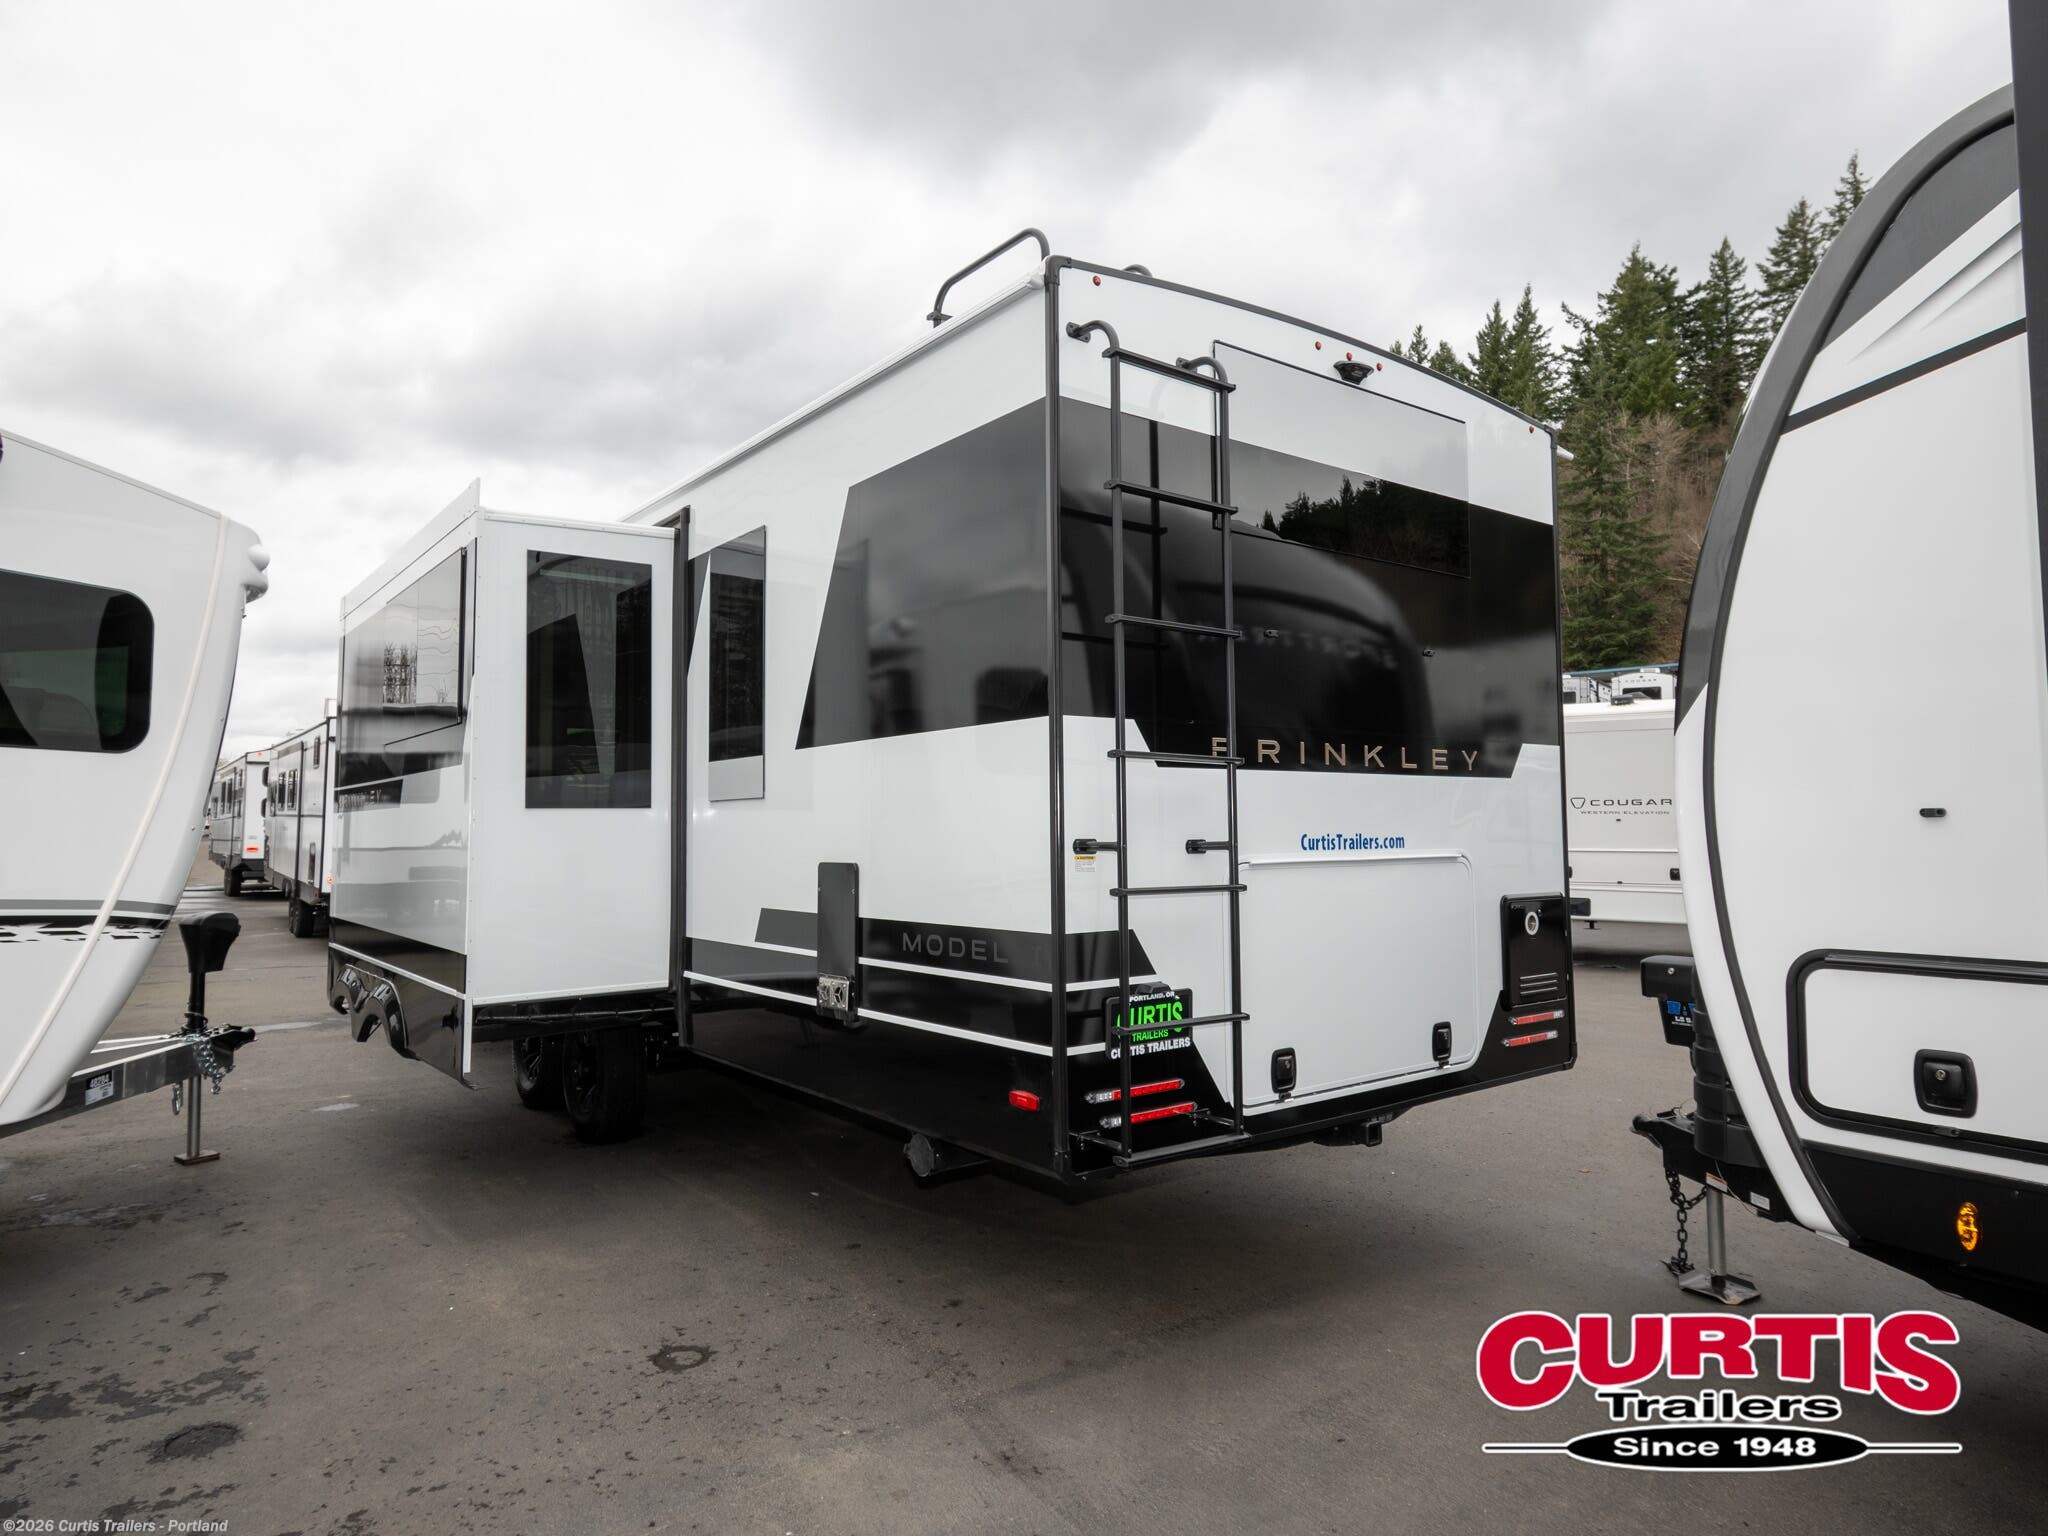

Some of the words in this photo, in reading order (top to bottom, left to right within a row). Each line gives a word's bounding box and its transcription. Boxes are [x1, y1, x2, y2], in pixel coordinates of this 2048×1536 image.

[1590, 799, 1673, 807] COUGAR
[1300, 833, 1405, 851] CurtisTrailers.com
[902, 932, 1009, 963] MODEL
[1116, 1001, 1183, 1038] URTIS
[1132, 1029, 1169, 1042] TRAILERS
[1111, 1045, 1146, 1059] CTIS
[1147, 1037, 1191, 1053] TRAILERS
